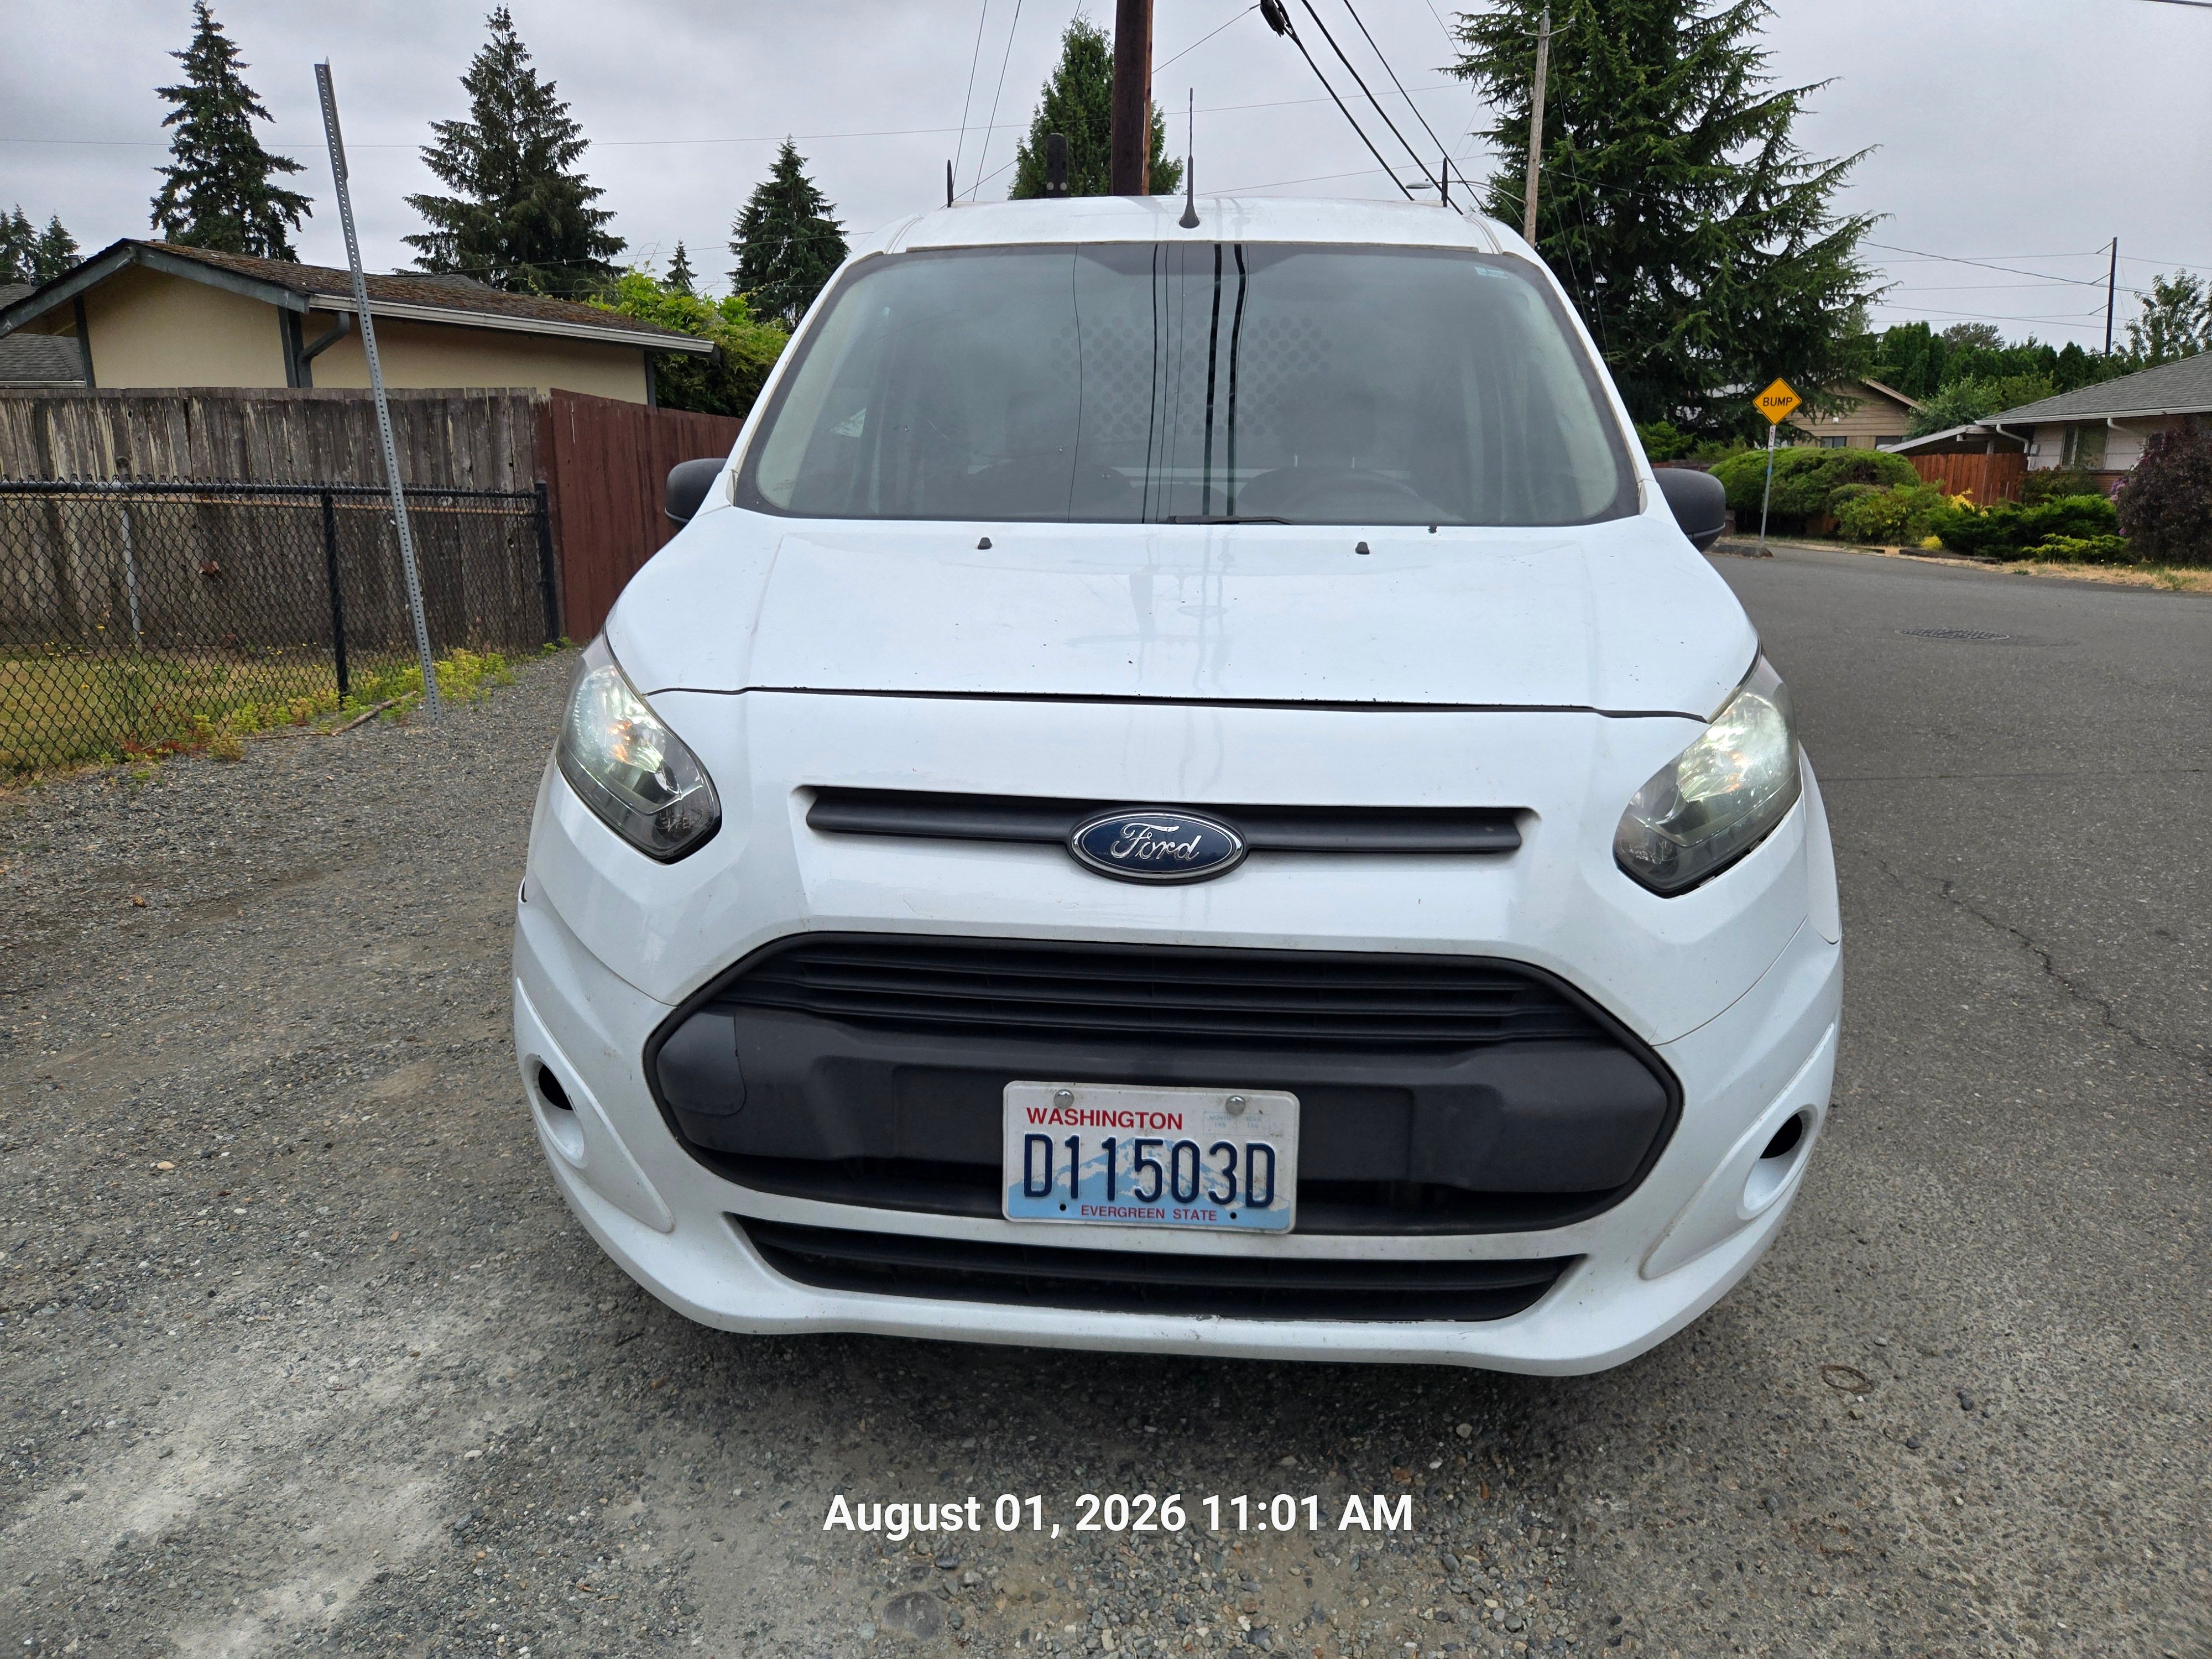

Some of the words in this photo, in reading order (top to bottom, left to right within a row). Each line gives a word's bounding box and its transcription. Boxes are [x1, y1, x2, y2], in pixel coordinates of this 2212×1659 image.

[1763, 397, 1792, 406] BUMP
[1110, 822, 1202, 860] Ford
[1026, 1107, 1182, 1130] WASHINGTON
[1024, 1133, 1274, 1207] D11503D
[1081, 1204, 1165, 1219] EVERGREEN
[1173, 1208, 1217, 1221] STATE
